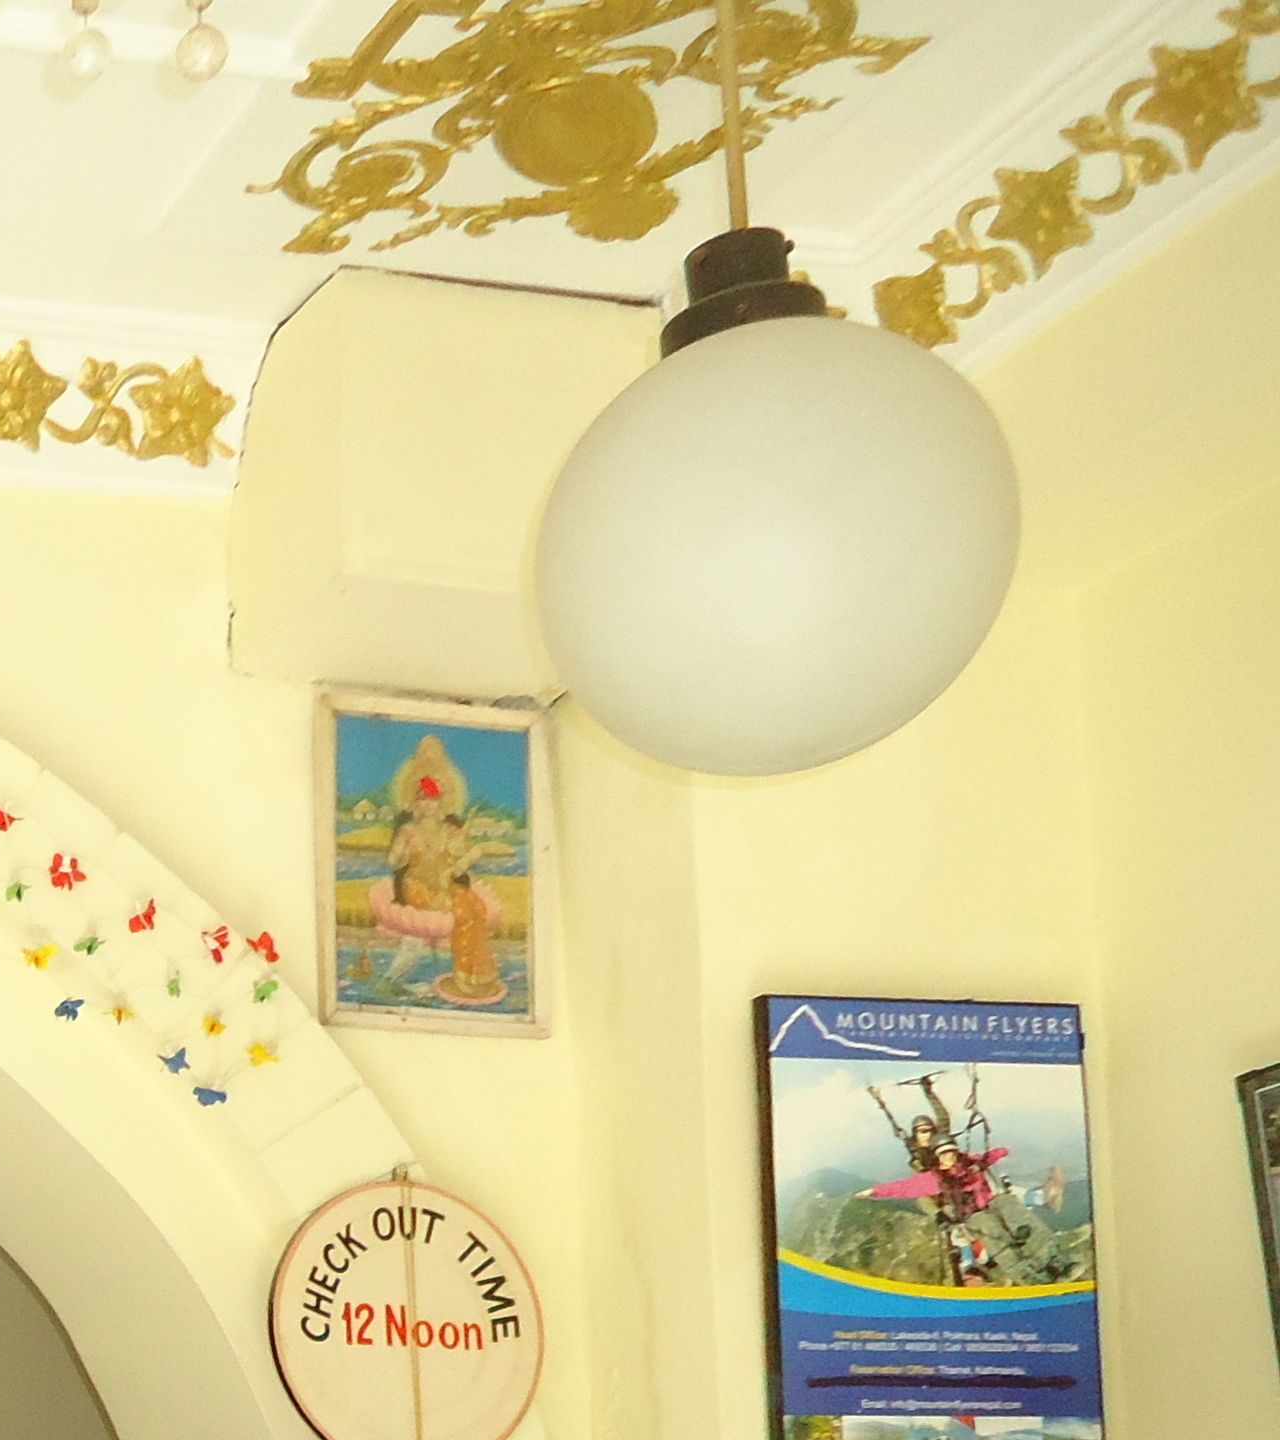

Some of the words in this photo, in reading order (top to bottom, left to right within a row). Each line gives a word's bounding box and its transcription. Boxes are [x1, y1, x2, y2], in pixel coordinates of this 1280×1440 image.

[836, 1012, 979, 1031] MOUNTAIN
[987, 1015, 1074, 1035] FLYERS
[300, 1222, 368, 1342] CHECK
[372, 1206, 445, 1244] OUT
[458, 1231, 521, 1343] TIME
[341, 1302, 375, 1345] 12
[385, 1304, 483, 1350] Noon
